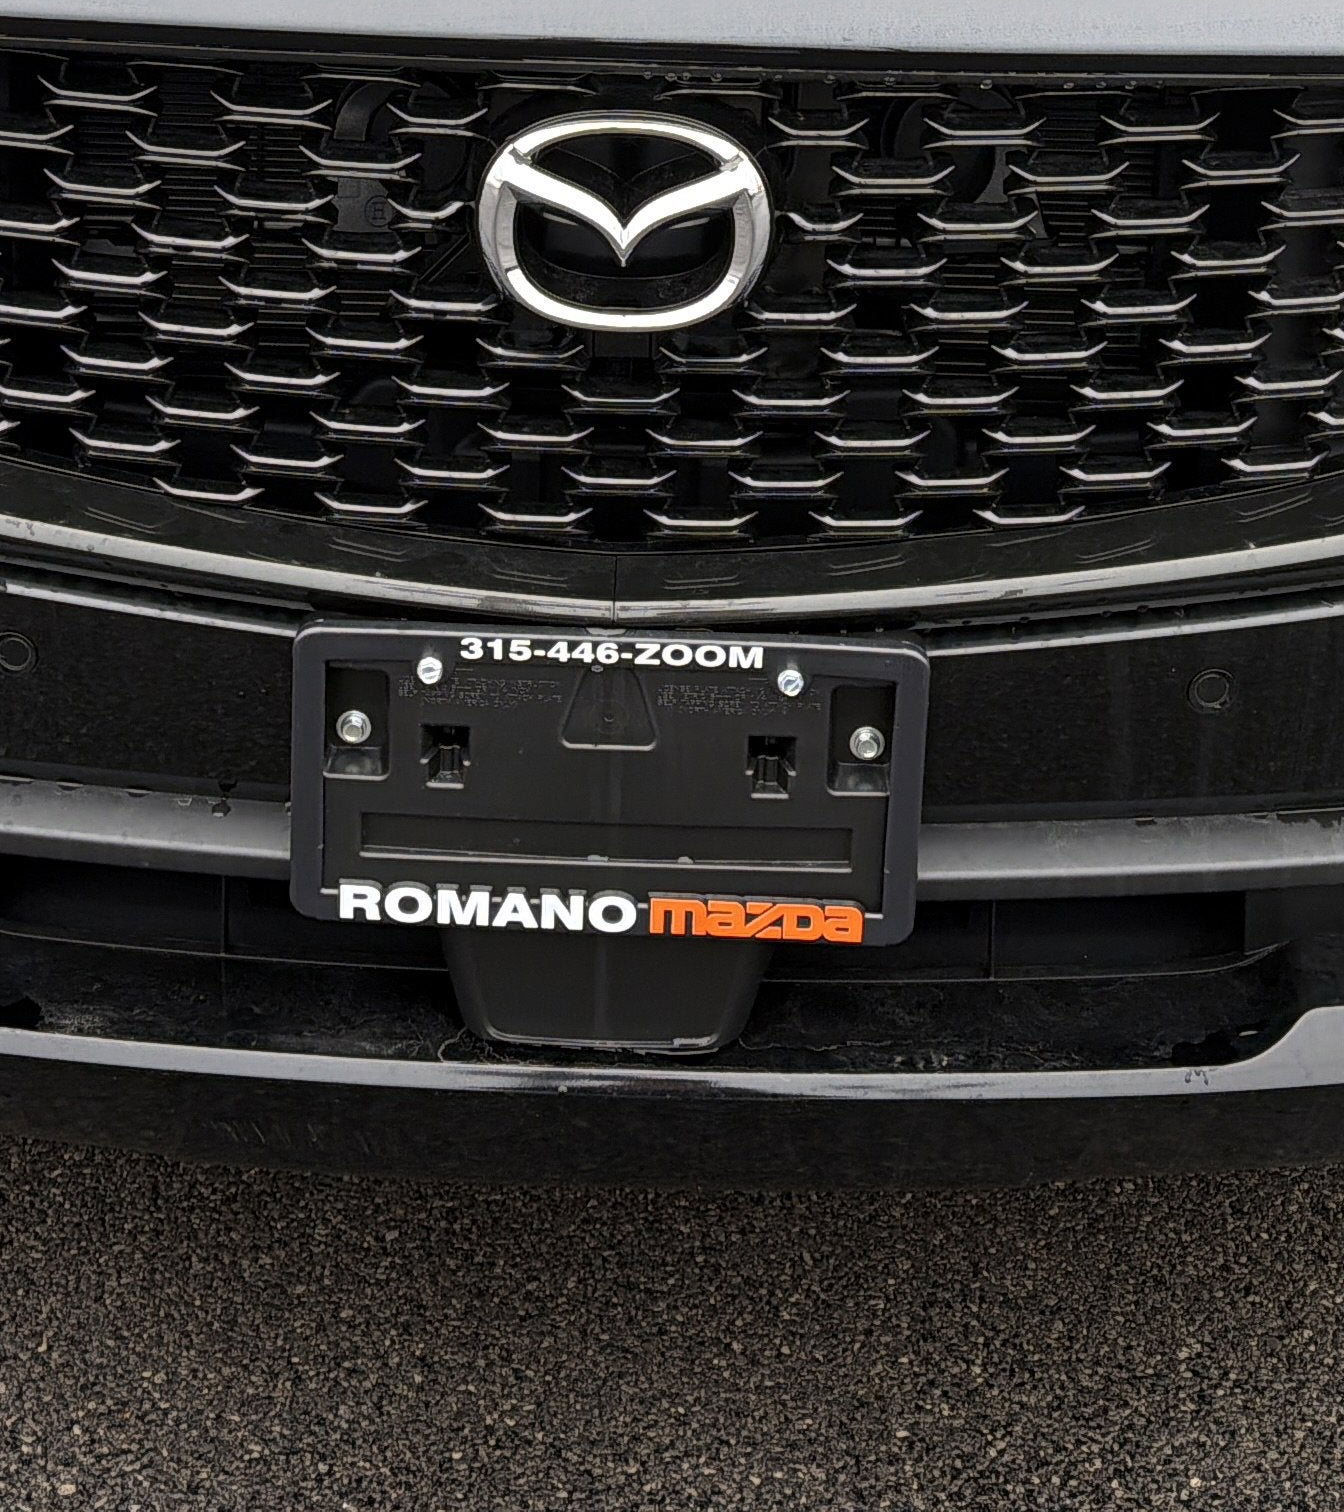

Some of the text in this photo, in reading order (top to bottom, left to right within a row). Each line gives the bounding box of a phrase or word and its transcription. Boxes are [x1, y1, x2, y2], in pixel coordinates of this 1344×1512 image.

[459, 636, 764, 670] 315-446-ZOOM
[338, 884, 864, 943] ROMANO mazda
